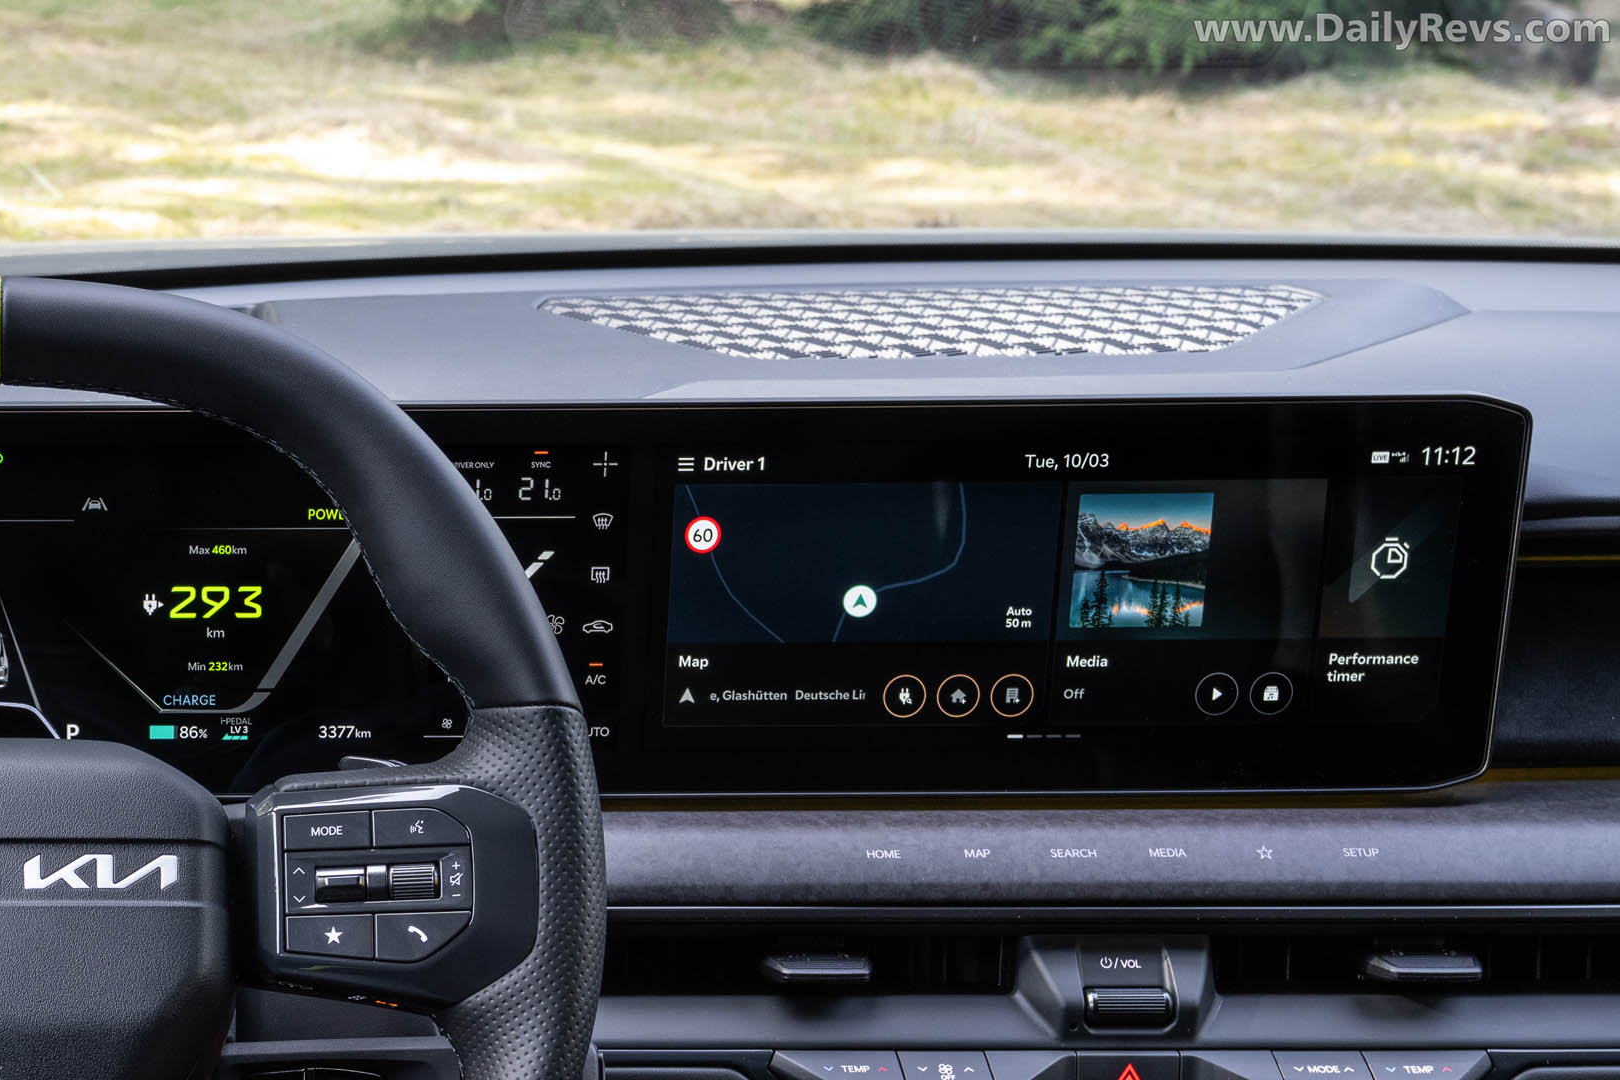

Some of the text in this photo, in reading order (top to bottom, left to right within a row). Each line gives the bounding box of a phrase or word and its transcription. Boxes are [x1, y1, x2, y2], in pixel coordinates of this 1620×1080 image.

[1024, 452, 1110, 471] Tue, 10/03
[1421, 445, 1476, 466] 11:12
[453, 460, 495, 470] RIVER ONLY
[531, 461, 551, 469] SYNC
[703, 455, 765, 473] Driver 1
[476, 479, 492, 501] 1.0
[519, 477, 561, 500] 21.0
[692, 528, 713, 543] 60
[188, 544, 210, 555] Max
[170, 586, 262, 618] 293
[1005, 605, 1033, 618] Auto
[1005, 617, 1020, 629] 50
[206, 626, 225, 639] km
[678, 655, 709, 670] Map
[1066, 655, 1109, 668] Media
[1327, 652, 1420, 667] Performance
[187, 661, 207, 671] Min
[584, 674, 606, 685] A/C
[1326, 669, 1365, 682] timer
[163, 694, 216, 706] CHARGE
[722, 689, 788, 701] Glashütten
[795, 689, 850, 701] Deutsche
[1063, 688, 1085, 700] Off
[66, 722, 81, 741] P
[179, 725, 208, 739] 86%
[310, 826, 343, 837] MODE
[866, 849, 902, 859] HOME
[963, 848, 991, 859] MAP
[1049, 848, 1098, 858] SEARCH
[1148, 847, 1188, 858] MEDIA
[1342, 847, 1380, 858] SETUP
[23, 854, 178, 889] KIA
[840, 1064, 871, 1073] TEMP
[1306, 1065, 1342, 1074] MODE
[1402, 1065, 1434, 1075] TEMP
